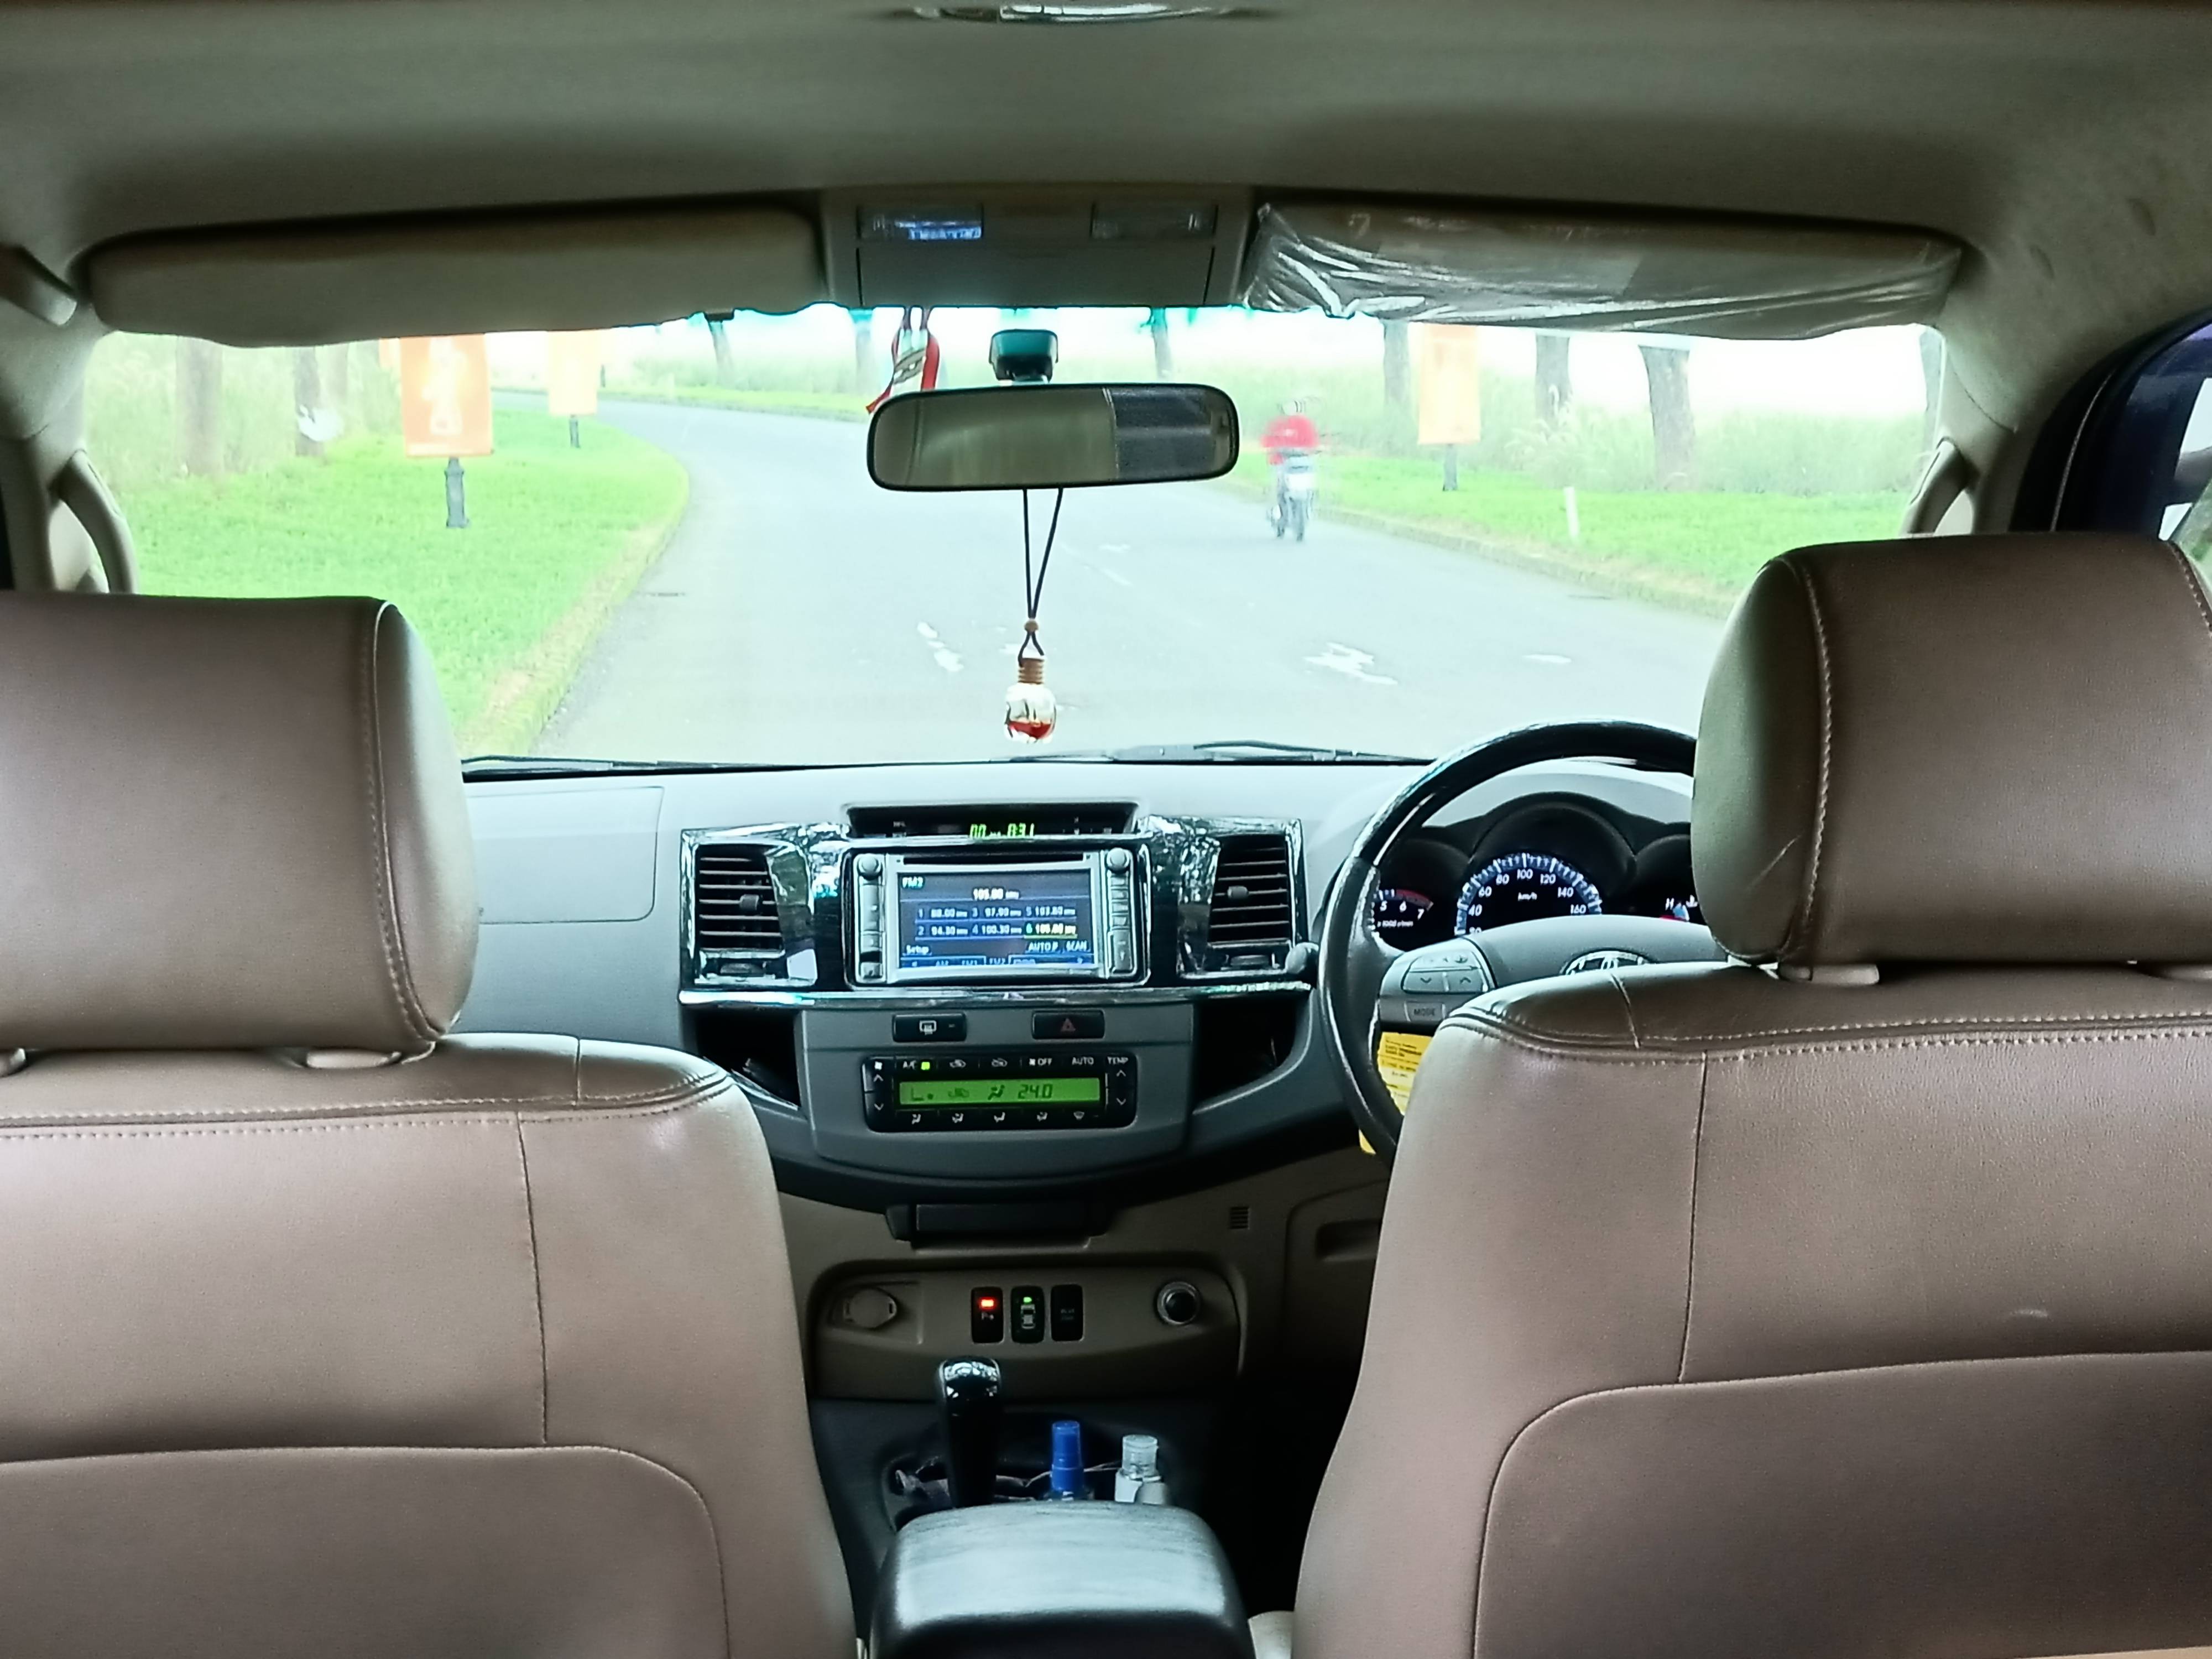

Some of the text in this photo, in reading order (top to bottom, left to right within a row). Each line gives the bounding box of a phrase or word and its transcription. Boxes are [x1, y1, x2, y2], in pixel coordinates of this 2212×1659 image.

[1495, 874, 1510, 885] 80
[1516, 869, 1533, 880] 100
[1540, 874, 1556, 885] 120
[1478, 886, 1492, 898] 60
[1517, 891, 1537, 901] km/h
[1557, 886, 1574, 898] 140
[1379, 900, 1388, 912] 5
[1399, 900, 1407, 913] 6
[1468, 904, 1483, 916] 40
[1570, 904, 1587, 914] 160
[1417, 908, 1425, 920] 7
[972, 924, 979, 935] 4
[1037, 1058, 1052, 1066] OFF
[1072, 1057, 1094, 1065] AUTO
